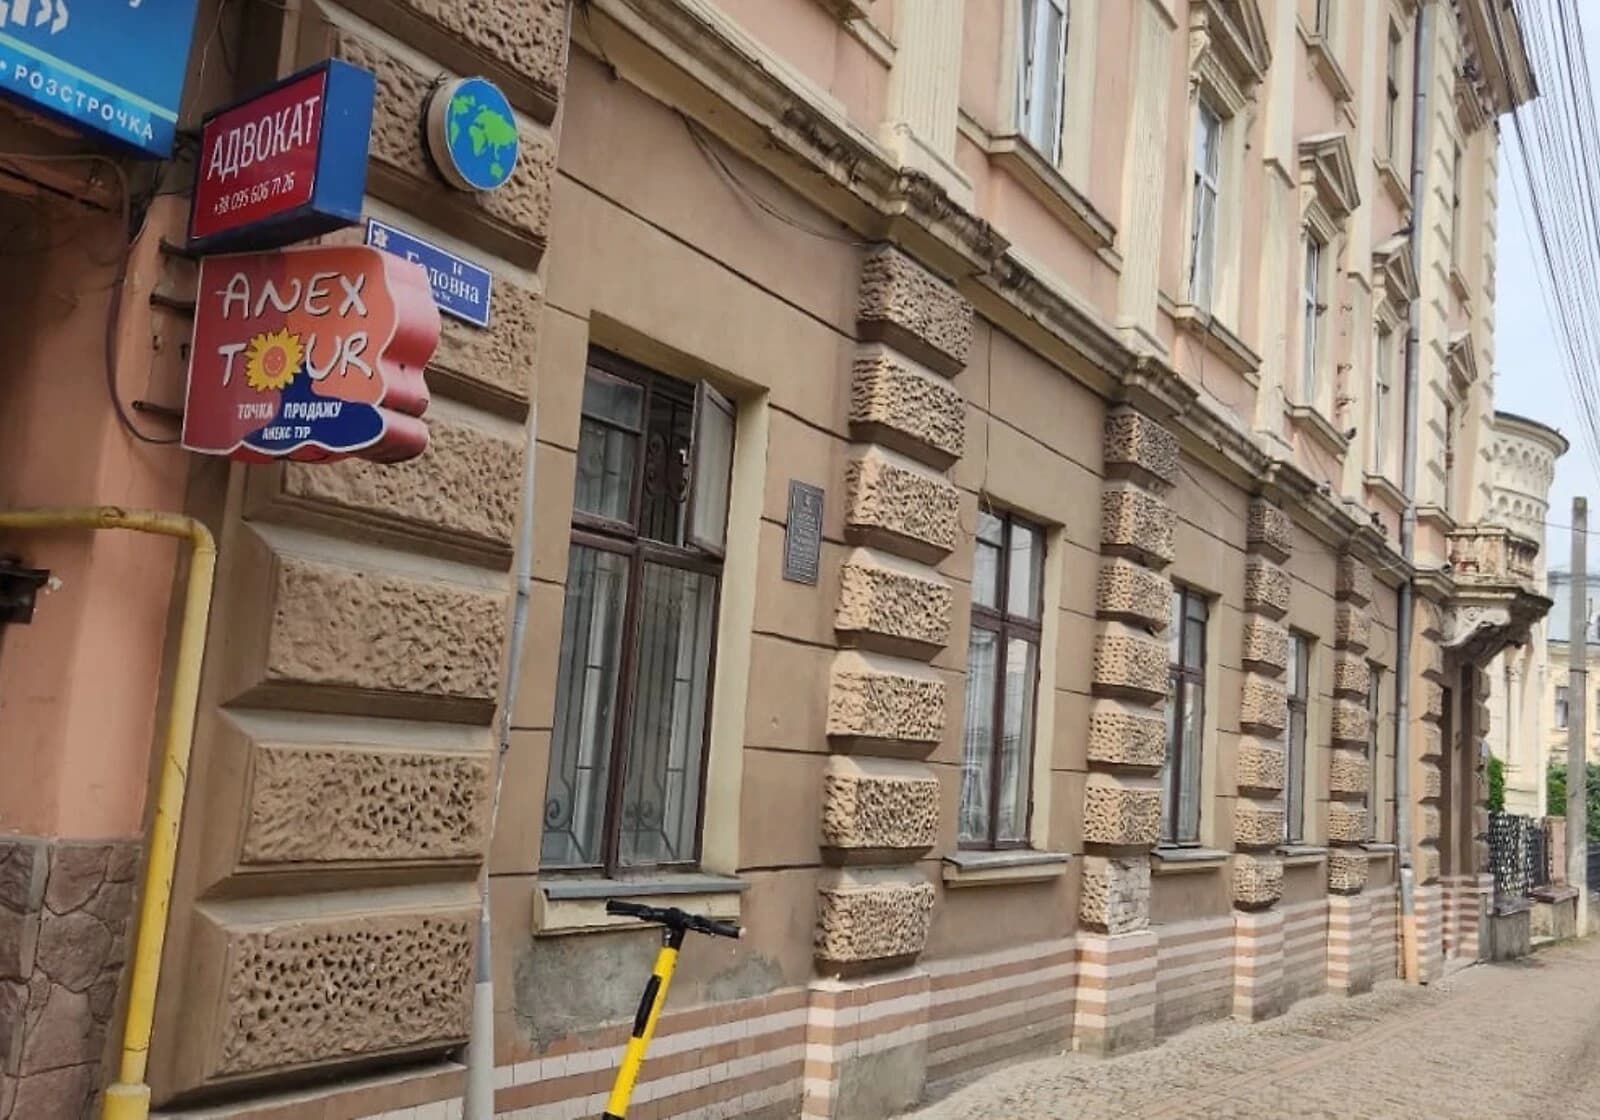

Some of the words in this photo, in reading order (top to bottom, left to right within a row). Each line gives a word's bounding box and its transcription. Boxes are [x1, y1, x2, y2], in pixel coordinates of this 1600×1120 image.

[14, 63, 153, 140] РОЗСТРОЧКА
[207, 95, 320, 184] АДВОКАТ
[216, 271, 369, 319] ANEX
[406, 250, 480, 305] Гловна
[237, 402, 274, 420] ТОЧКА
[283, 401, 343, 422] ПРОДАЖУ
[262, 426, 292, 441] АНЕКС
[294, 426, 312, 439] ТУР
